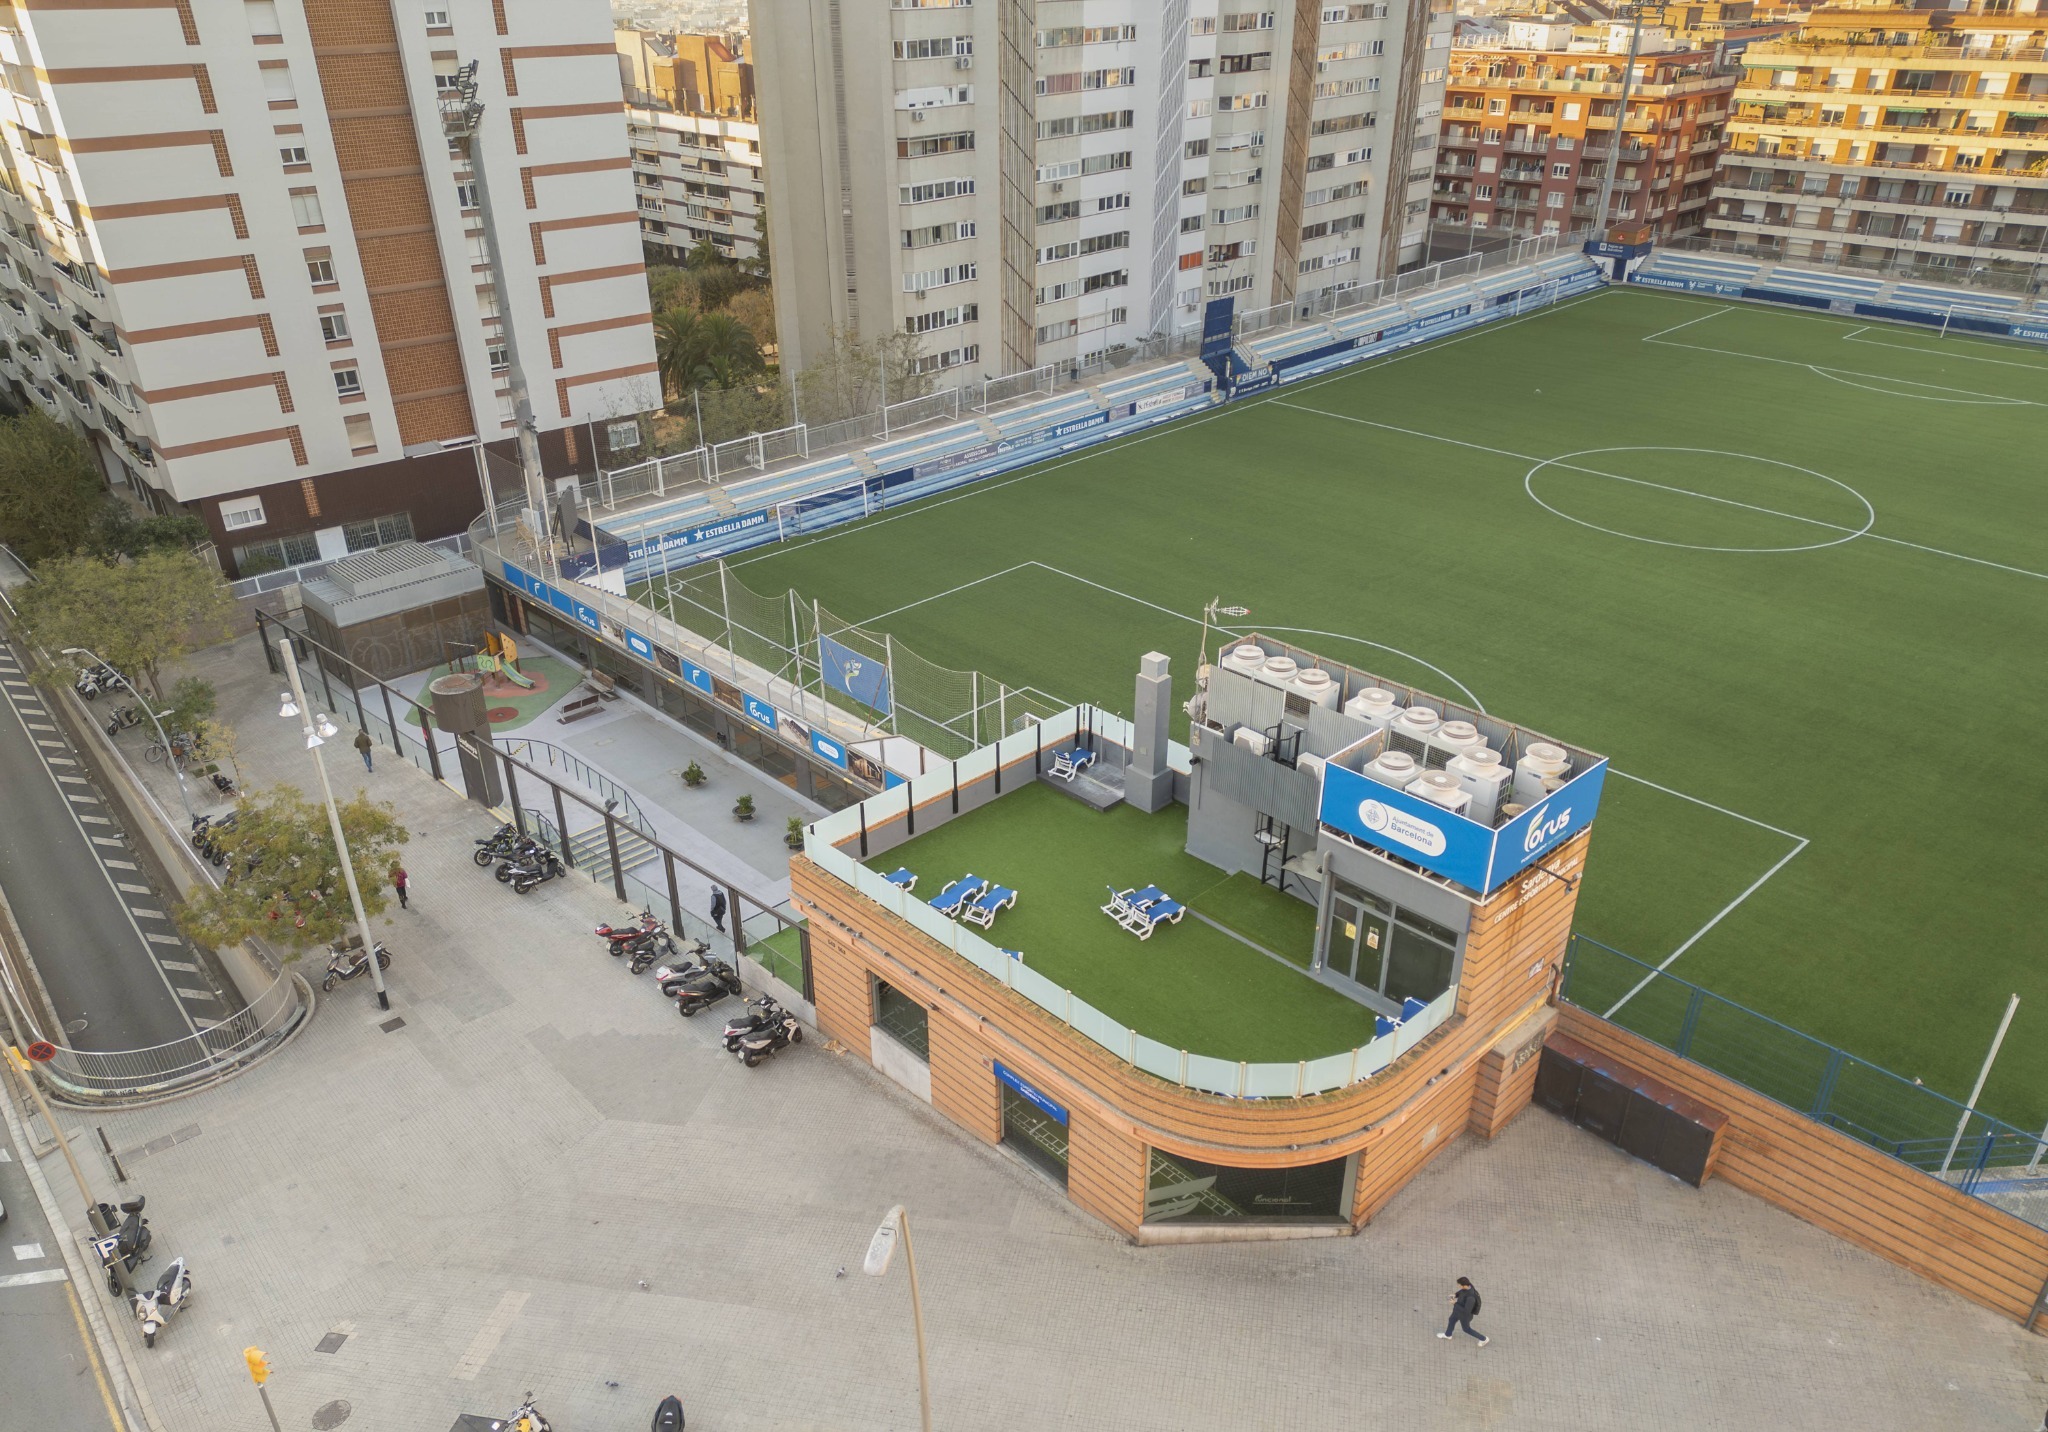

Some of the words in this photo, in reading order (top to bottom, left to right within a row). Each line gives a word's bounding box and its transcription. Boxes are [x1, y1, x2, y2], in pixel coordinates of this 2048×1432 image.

[1641, 277, 1667, 286] ESTRELLA
[1667, 280, 1684, 288] DAMM
[1062, 421, 1088, 435] ESTRELLA
[1088, 416, 1104, 428] DAMM
[705, 521, 741, 538] ESTRELLA
[741, 515, 765, 528] DAMM
[628, 543, 661, 560] STRELLA
[662, 536, 688, 551] DAMM
[1391, 822, 1433, 847] Barcelona
[1392, 816, 1426, 835] Ajuntament
[1426, 829, 1435, 838] de
[1494, 900, 1519, 924] CENTRE
[98, 1238, 118, 1259] P
